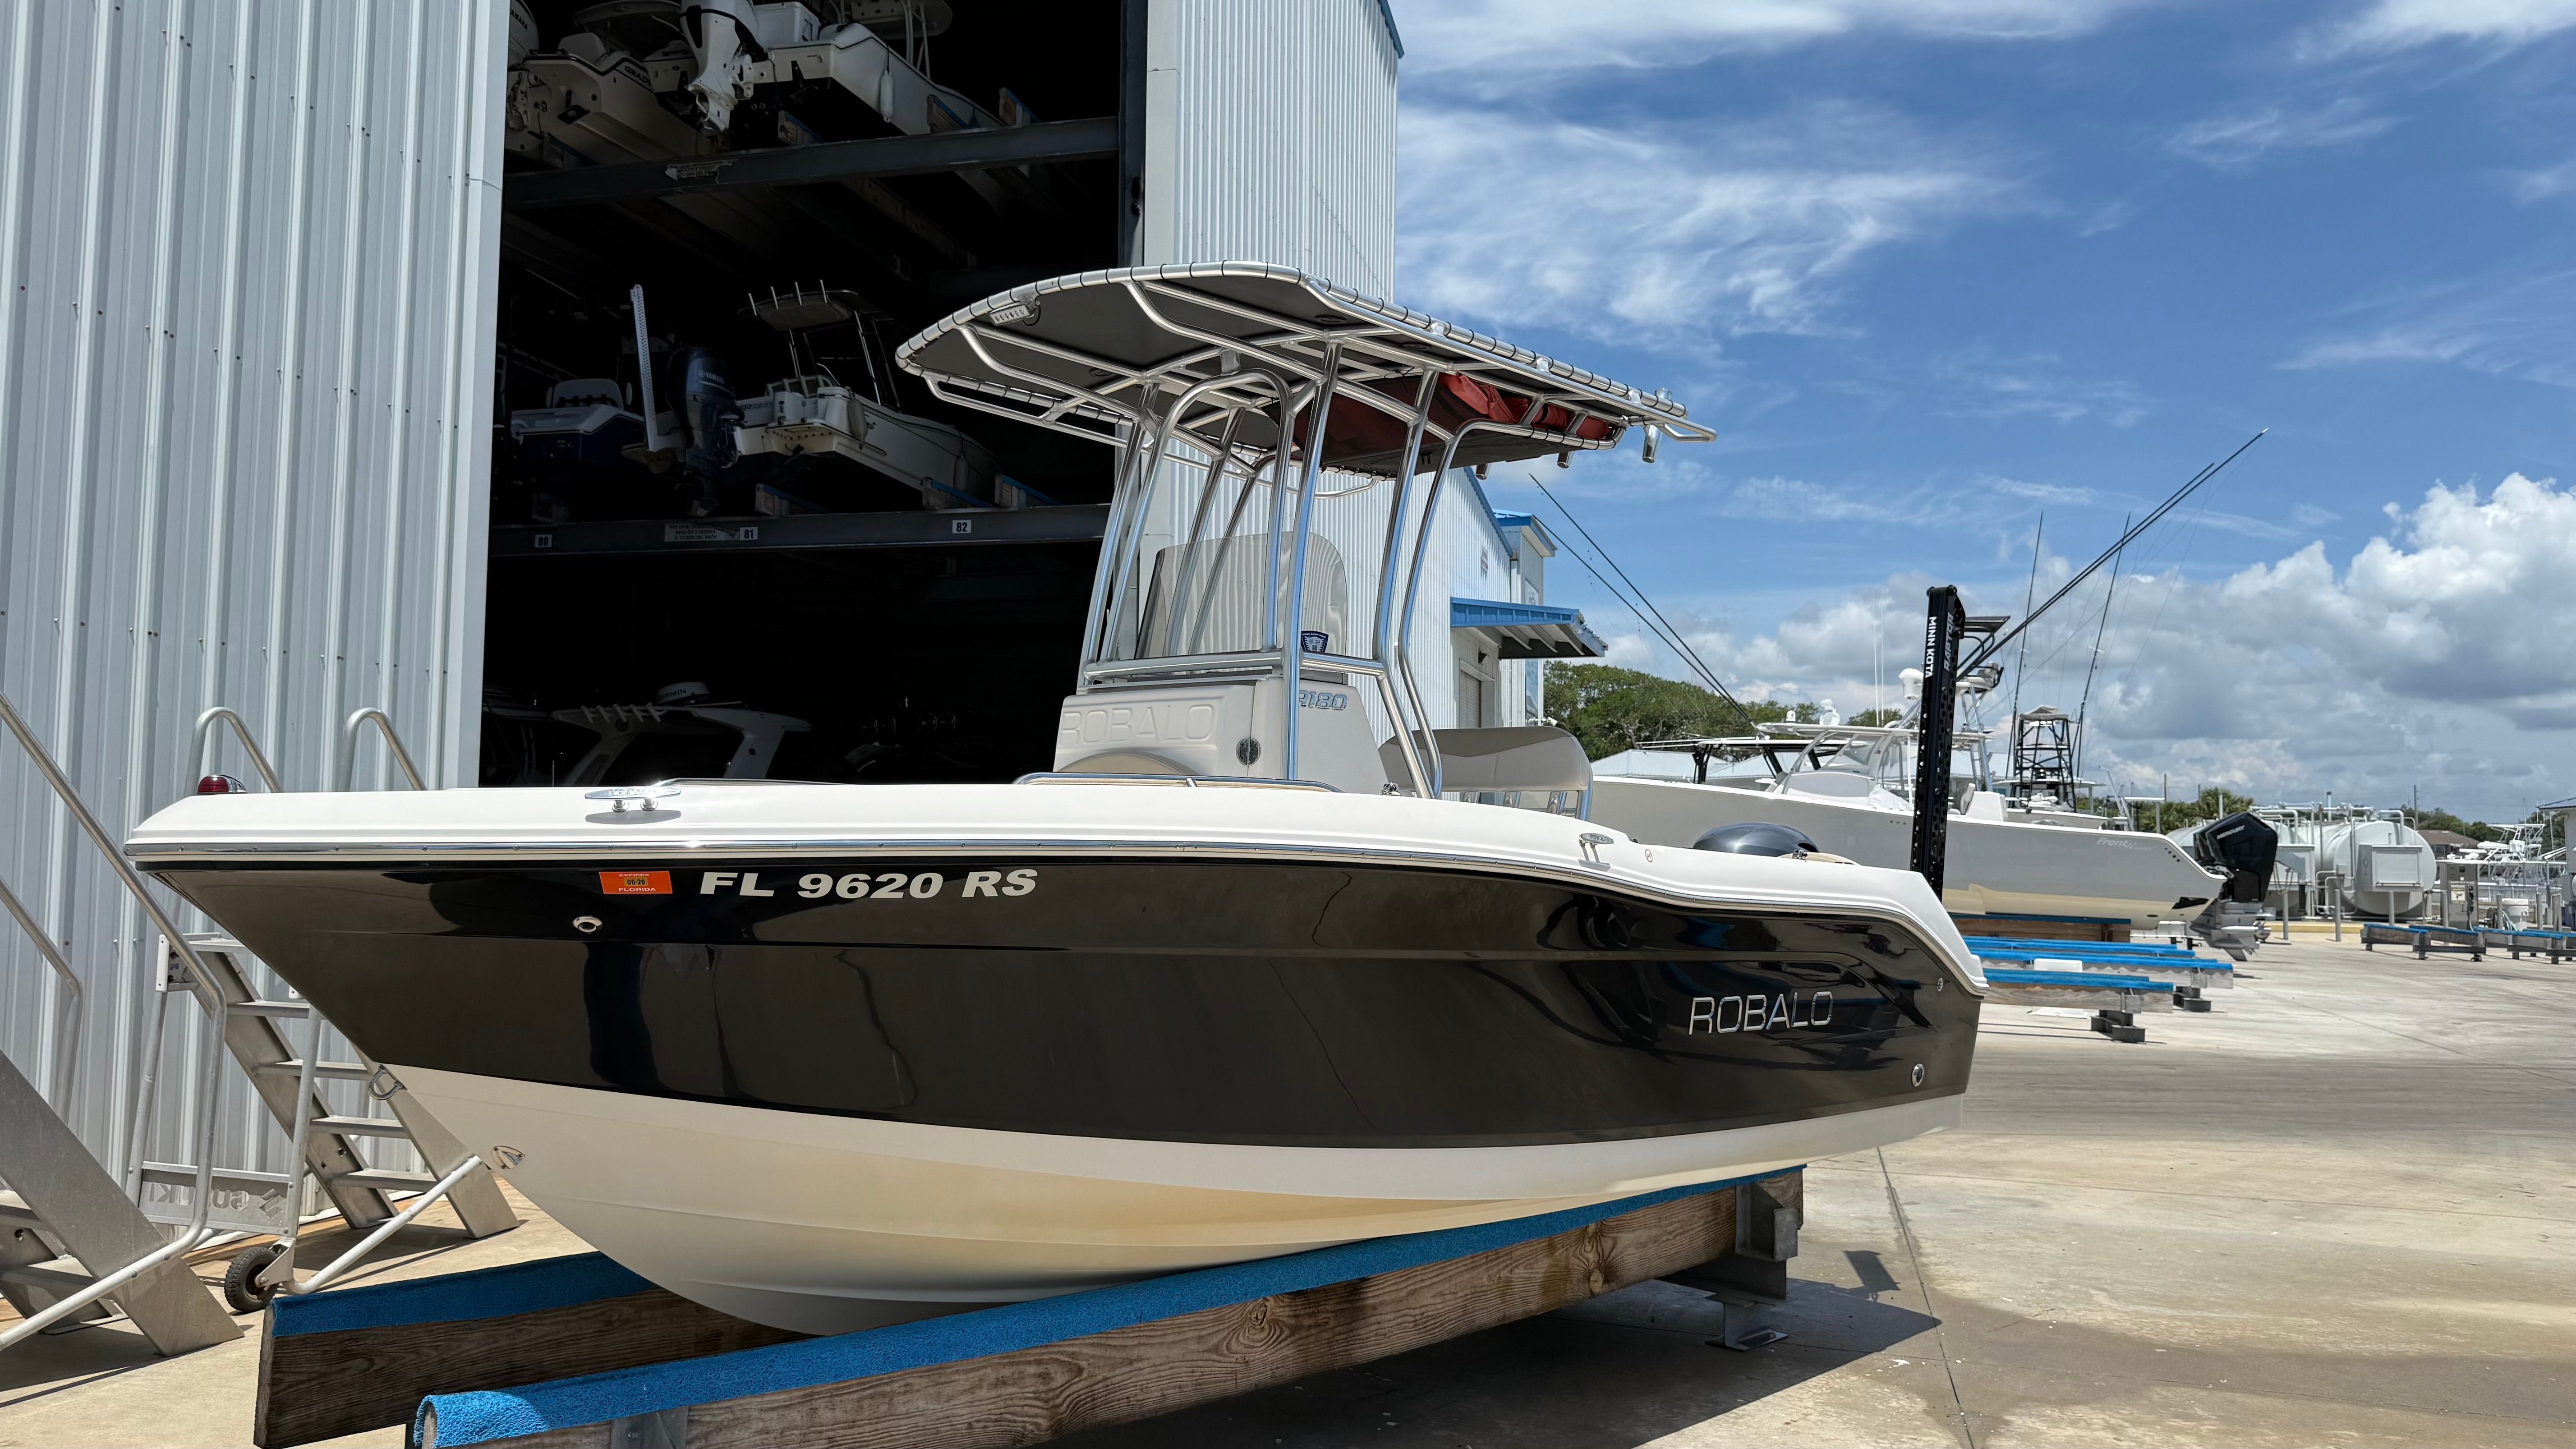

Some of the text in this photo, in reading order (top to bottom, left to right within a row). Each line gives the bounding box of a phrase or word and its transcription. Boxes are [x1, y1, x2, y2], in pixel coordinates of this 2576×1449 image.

[510, 9, 528, 30] AMAHA
[539, 537, 548, 546] 80
[744, 529, 754, 539] 81
[957, 522, 967, 532] 82
[1925, 616, 1937, 678] MINN KOTA
[1944, 612, 1954, 672] RAPTOR
[1058, 704, 1217, 747] ROBALO
[700, 869, 1039, 899] FL 9620 RS
[1688, 991, 1834, 1035] ROBALO
